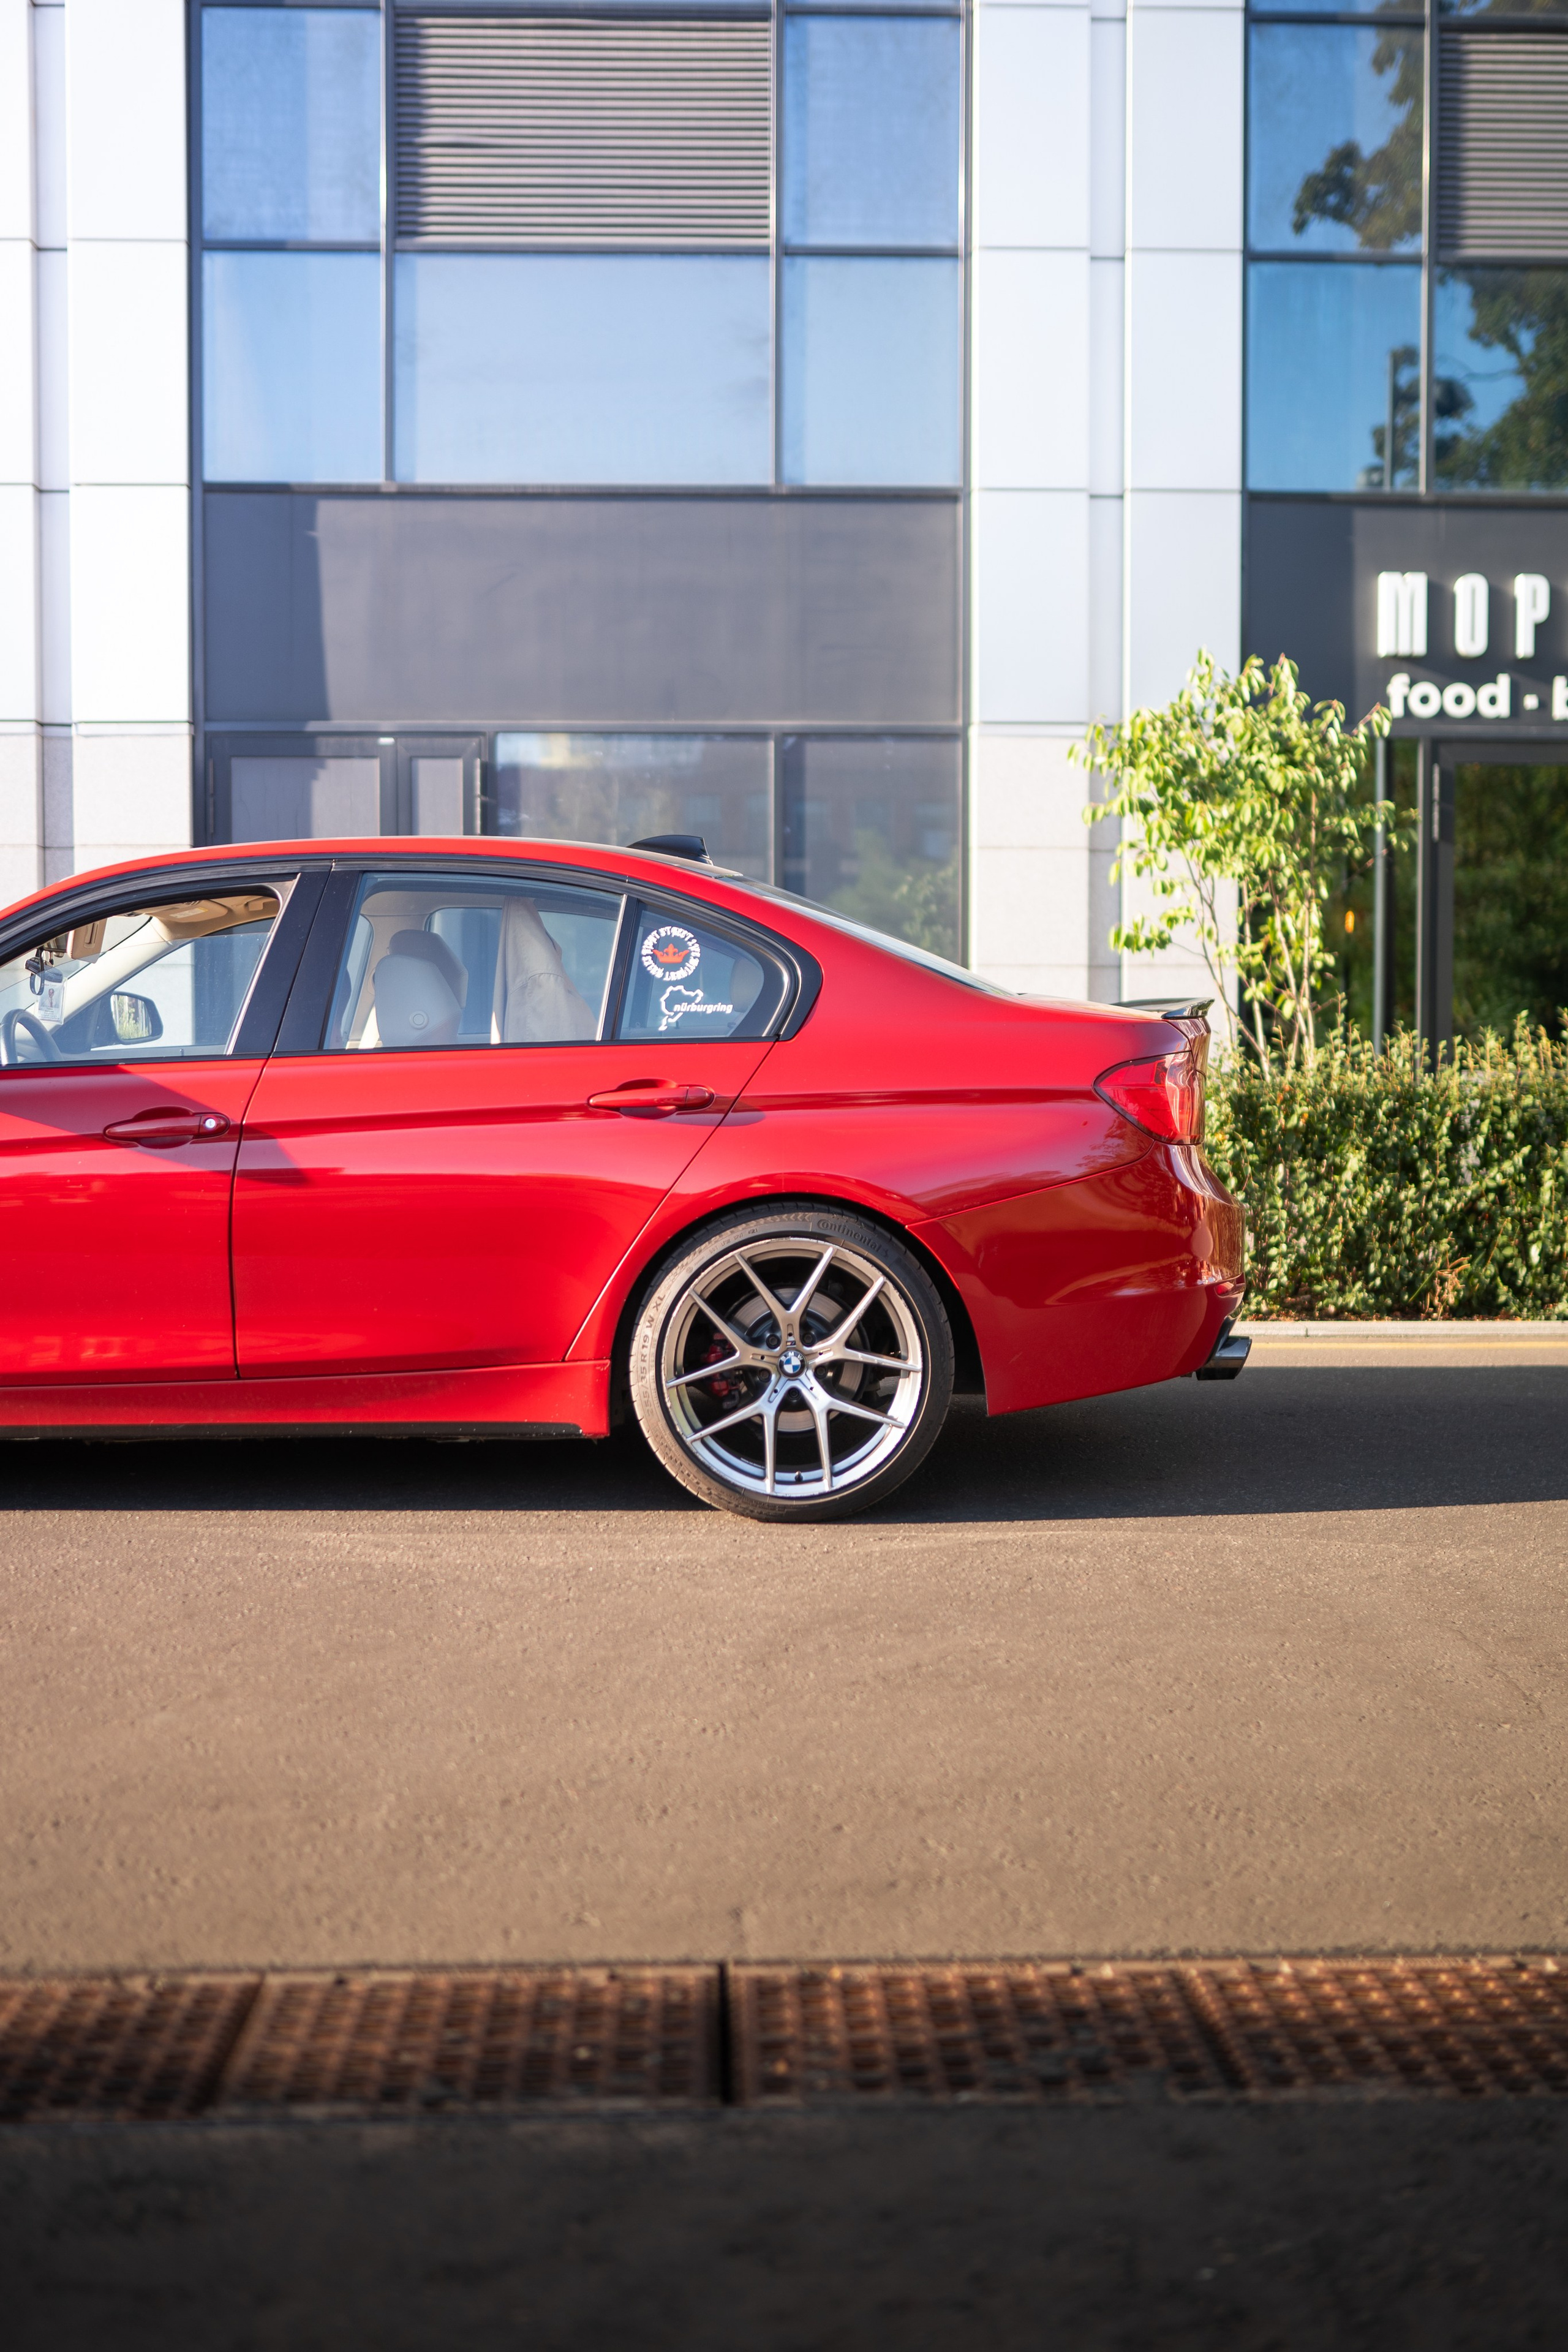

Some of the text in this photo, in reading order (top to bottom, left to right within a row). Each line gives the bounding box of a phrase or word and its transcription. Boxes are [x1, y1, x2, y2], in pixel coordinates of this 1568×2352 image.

[1386, 673, 1511, 719] food
[673, 1002, 734, 1014] nürburgring
[817, 1218, 882, 1252] Continental
[641, 1366, 654, 1416] 255/35
[652, 1294, 666, 1312] XL
[780, 1351, 803, 1361] BMW
